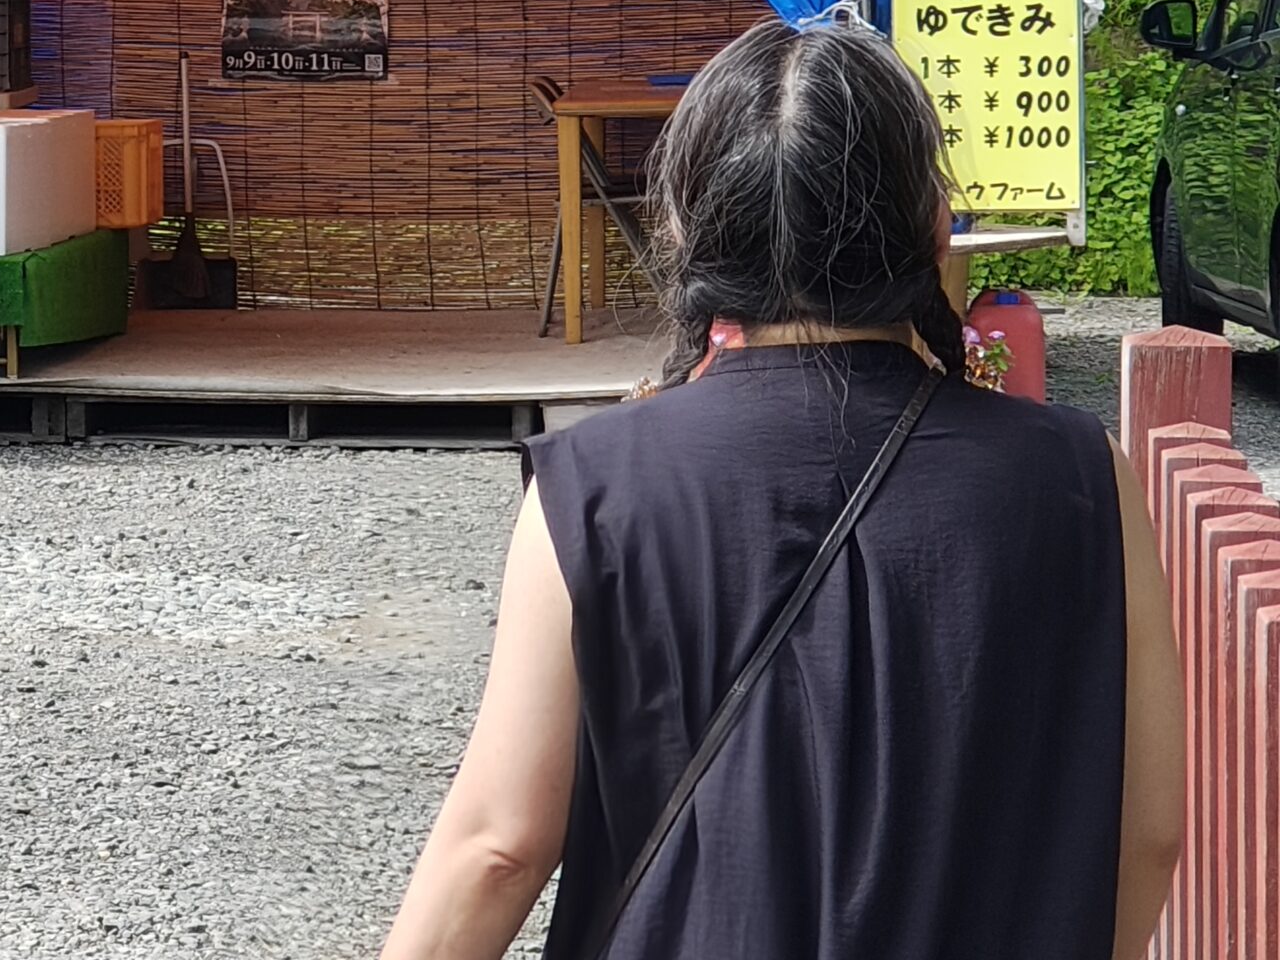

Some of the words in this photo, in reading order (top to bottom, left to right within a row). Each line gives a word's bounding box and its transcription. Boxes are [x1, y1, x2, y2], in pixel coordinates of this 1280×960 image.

[916, 3, 1057, 37] ゆできみ
[920, 54, 962, 80] 1本
[929, 89, 963, 114] 本
[983, 125, 1071, 149] ¥1000
